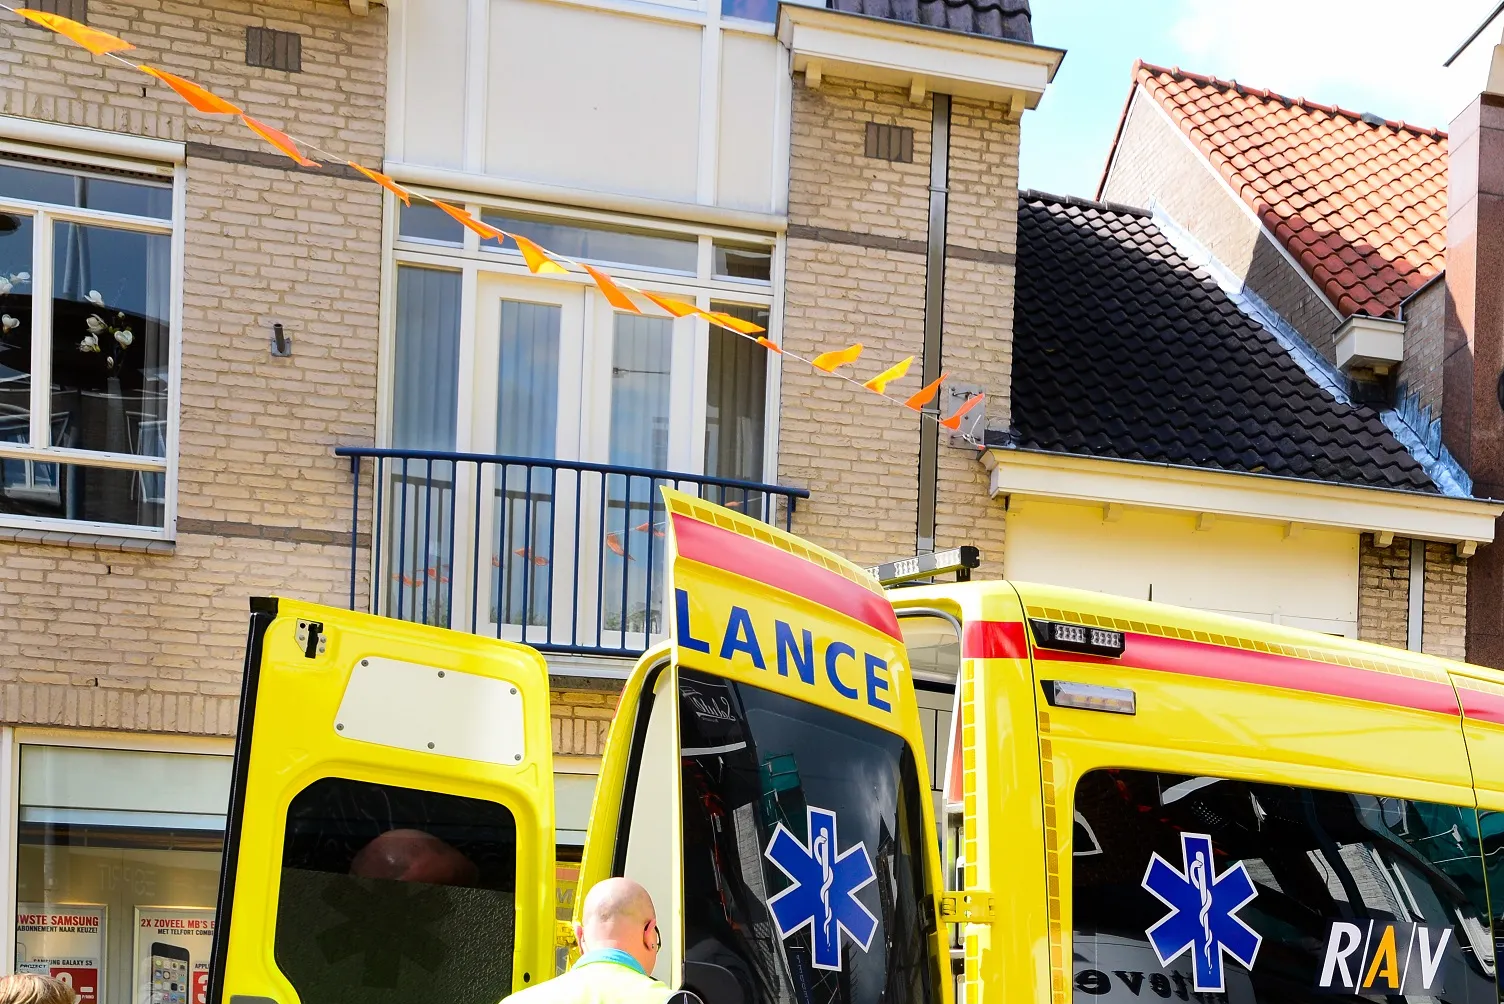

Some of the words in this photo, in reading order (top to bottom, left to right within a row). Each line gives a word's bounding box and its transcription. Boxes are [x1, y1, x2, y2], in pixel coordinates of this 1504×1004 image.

[51, 916, 98, 926] SAMSUNG
[141, 919, 151, 927] 2X
[154, 919, 184, 928] ZOVEEL
[188, 920, 208, 928] MB'S
